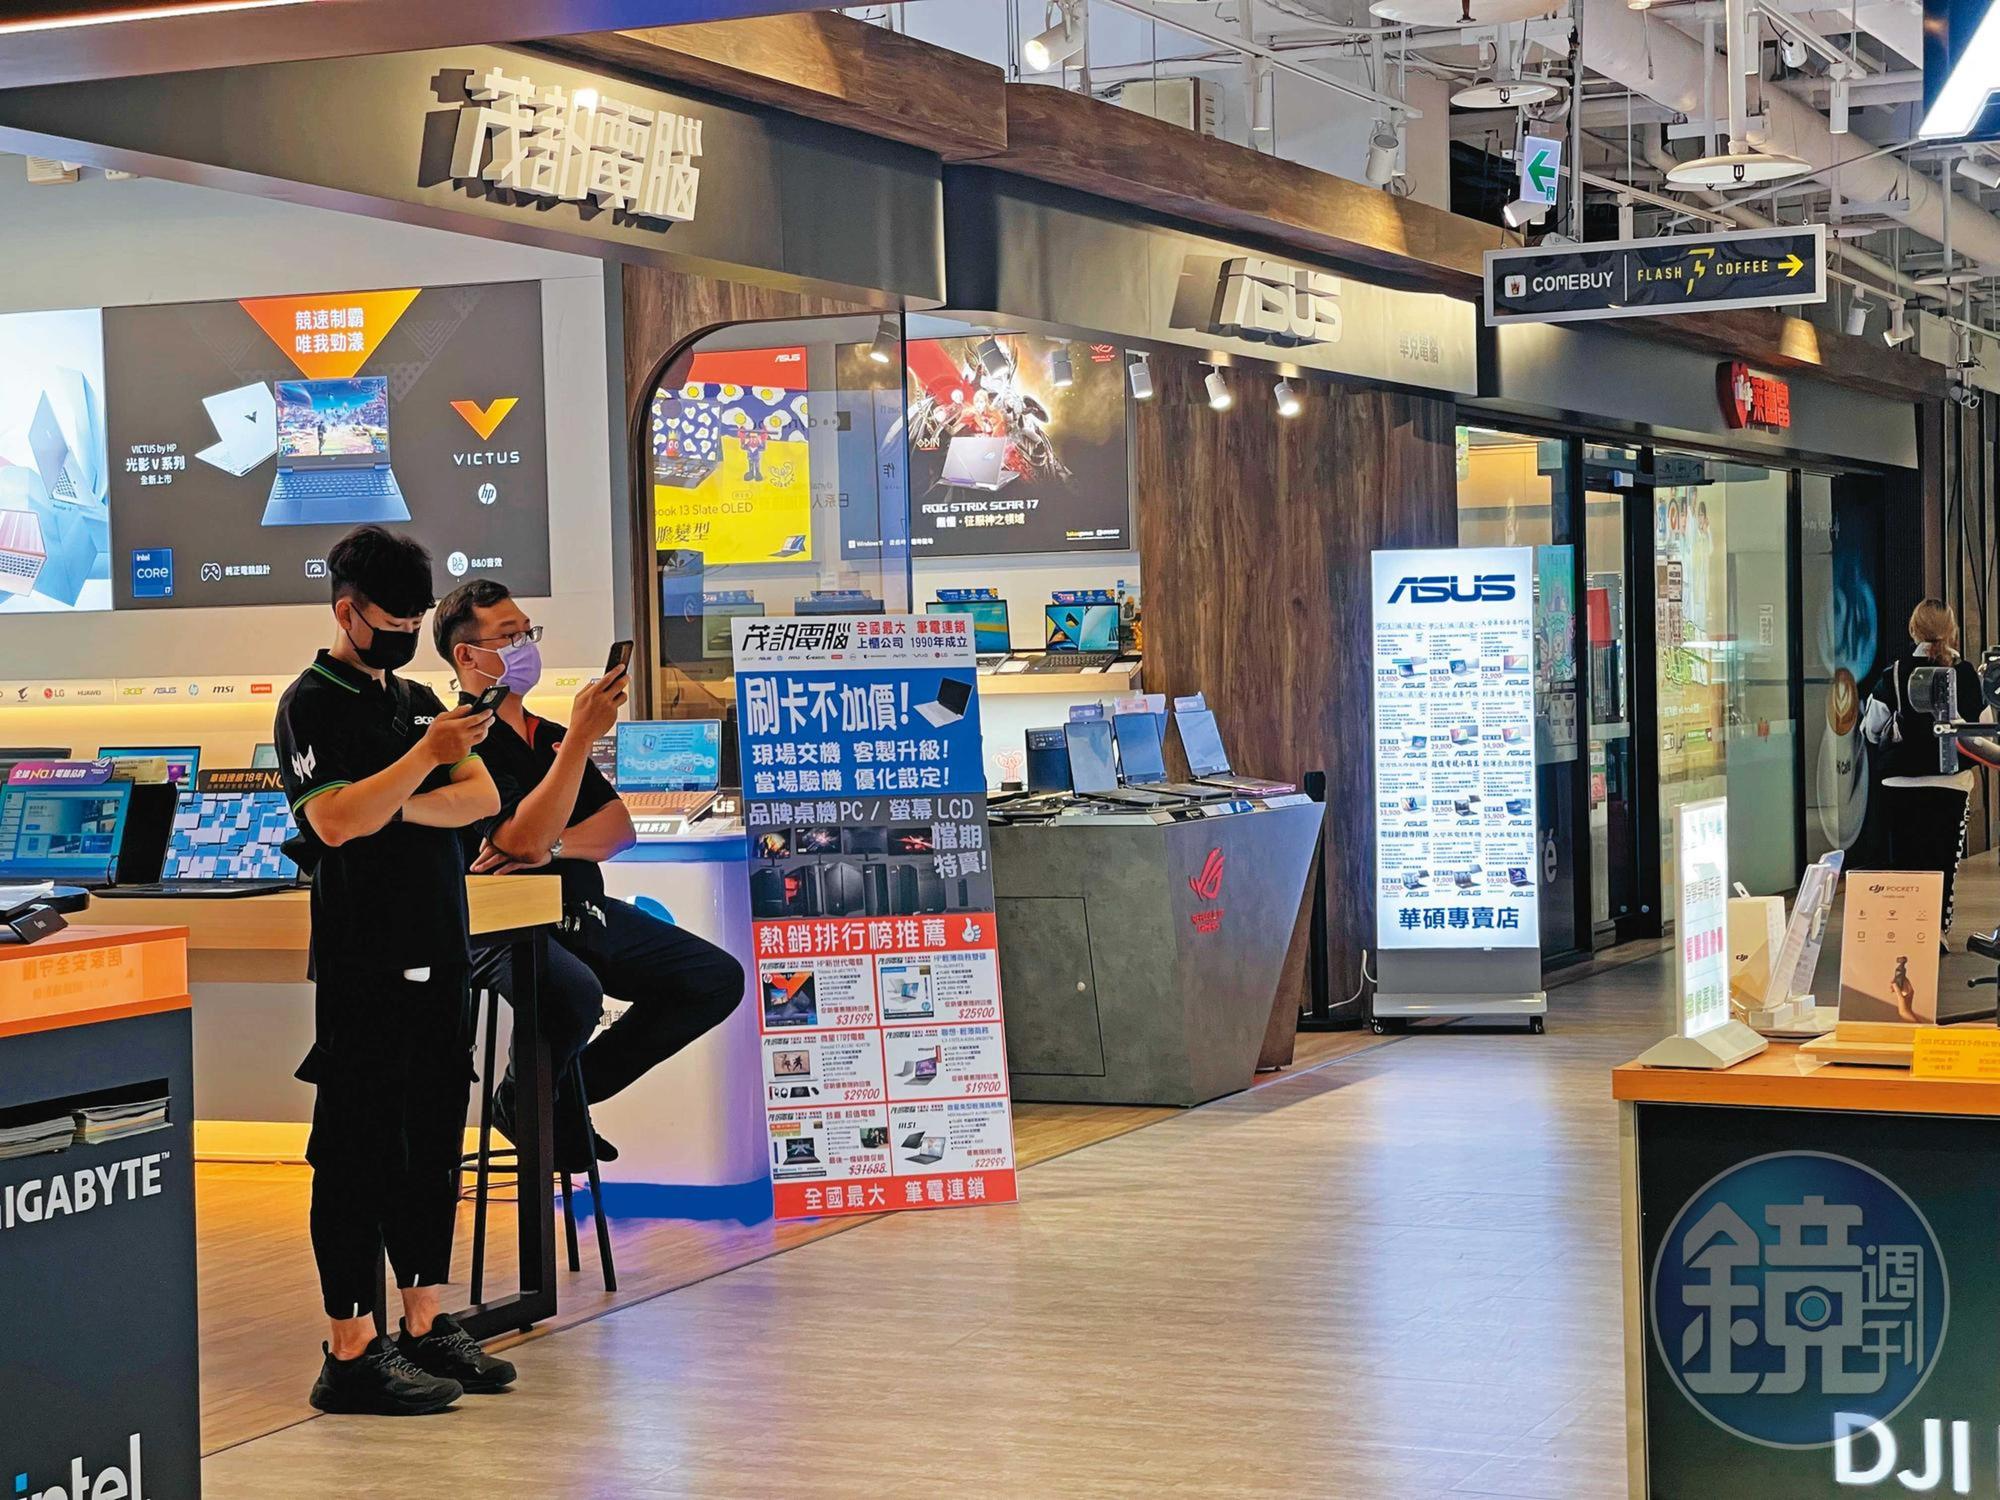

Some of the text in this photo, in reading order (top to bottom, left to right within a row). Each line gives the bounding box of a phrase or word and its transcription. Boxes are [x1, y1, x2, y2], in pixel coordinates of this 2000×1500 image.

[1637, 260, 1768, 282] FLASH COFFEE
[1532, 271, 1614, 293] COMEBUY
[1219, 256, 1343, 343] ASUS
[296, 307, 364, 330] 競速制霸
[296, 331, 364, 354] 唯我勁漾
[775, 353, 801, 362] ASUS
[131, 444, 177, 454] VICTUS by HP
[126, 455, 186, 472] 光影 V 系列
[453, 451, 520, 465] VICTUS
[140, 474, 172, 486] 全新上市
[479, 482, 496, 505] hp
[679, 504, 689, 516] 13
[693, 504, 718, 515] Slate
[721, 502, 753, 514] OLED
[922, 499, 1039, 513] ROG STRIX SCAR 17
[1387, 574, 1516, 604] ASUS
[856, 619, 967, 635] 全國最大 筆電連鎖
[742, 623, 851, 651] 茂訊電腦
[857, 636, 968, 649] 上櫃公司 1990年成立
[153, 686, 177, 695] ASUS
[213, 685, 234, 694] msi
[555, 678, 580, 687] acer
[744, 676, 909, 736] 刷卡不加價!
[414, 716, 435, 725] ace
[752, 739, 949, 766] 現場交機 客製升級!
[754, 767, 949, 793] 當場驗機 優化設定!
[934, 851, 987, 879] 特賣!
[1398, 907, 1520, 930] 華碩專賣店
[759, 919, 947, 954] 熱銷排行榜推薦
[836, 1013, 873, 1026] $31999
[958, 1007, 995, 1020] $25900
[844, 1088, 880, 1101] $29900
[965, 1081, 1001, 1094] $19900
[804, 1176, 987, 1211] 全國最大 筆電連鎖
[1834, 1411, 1971, 1494] DJI
